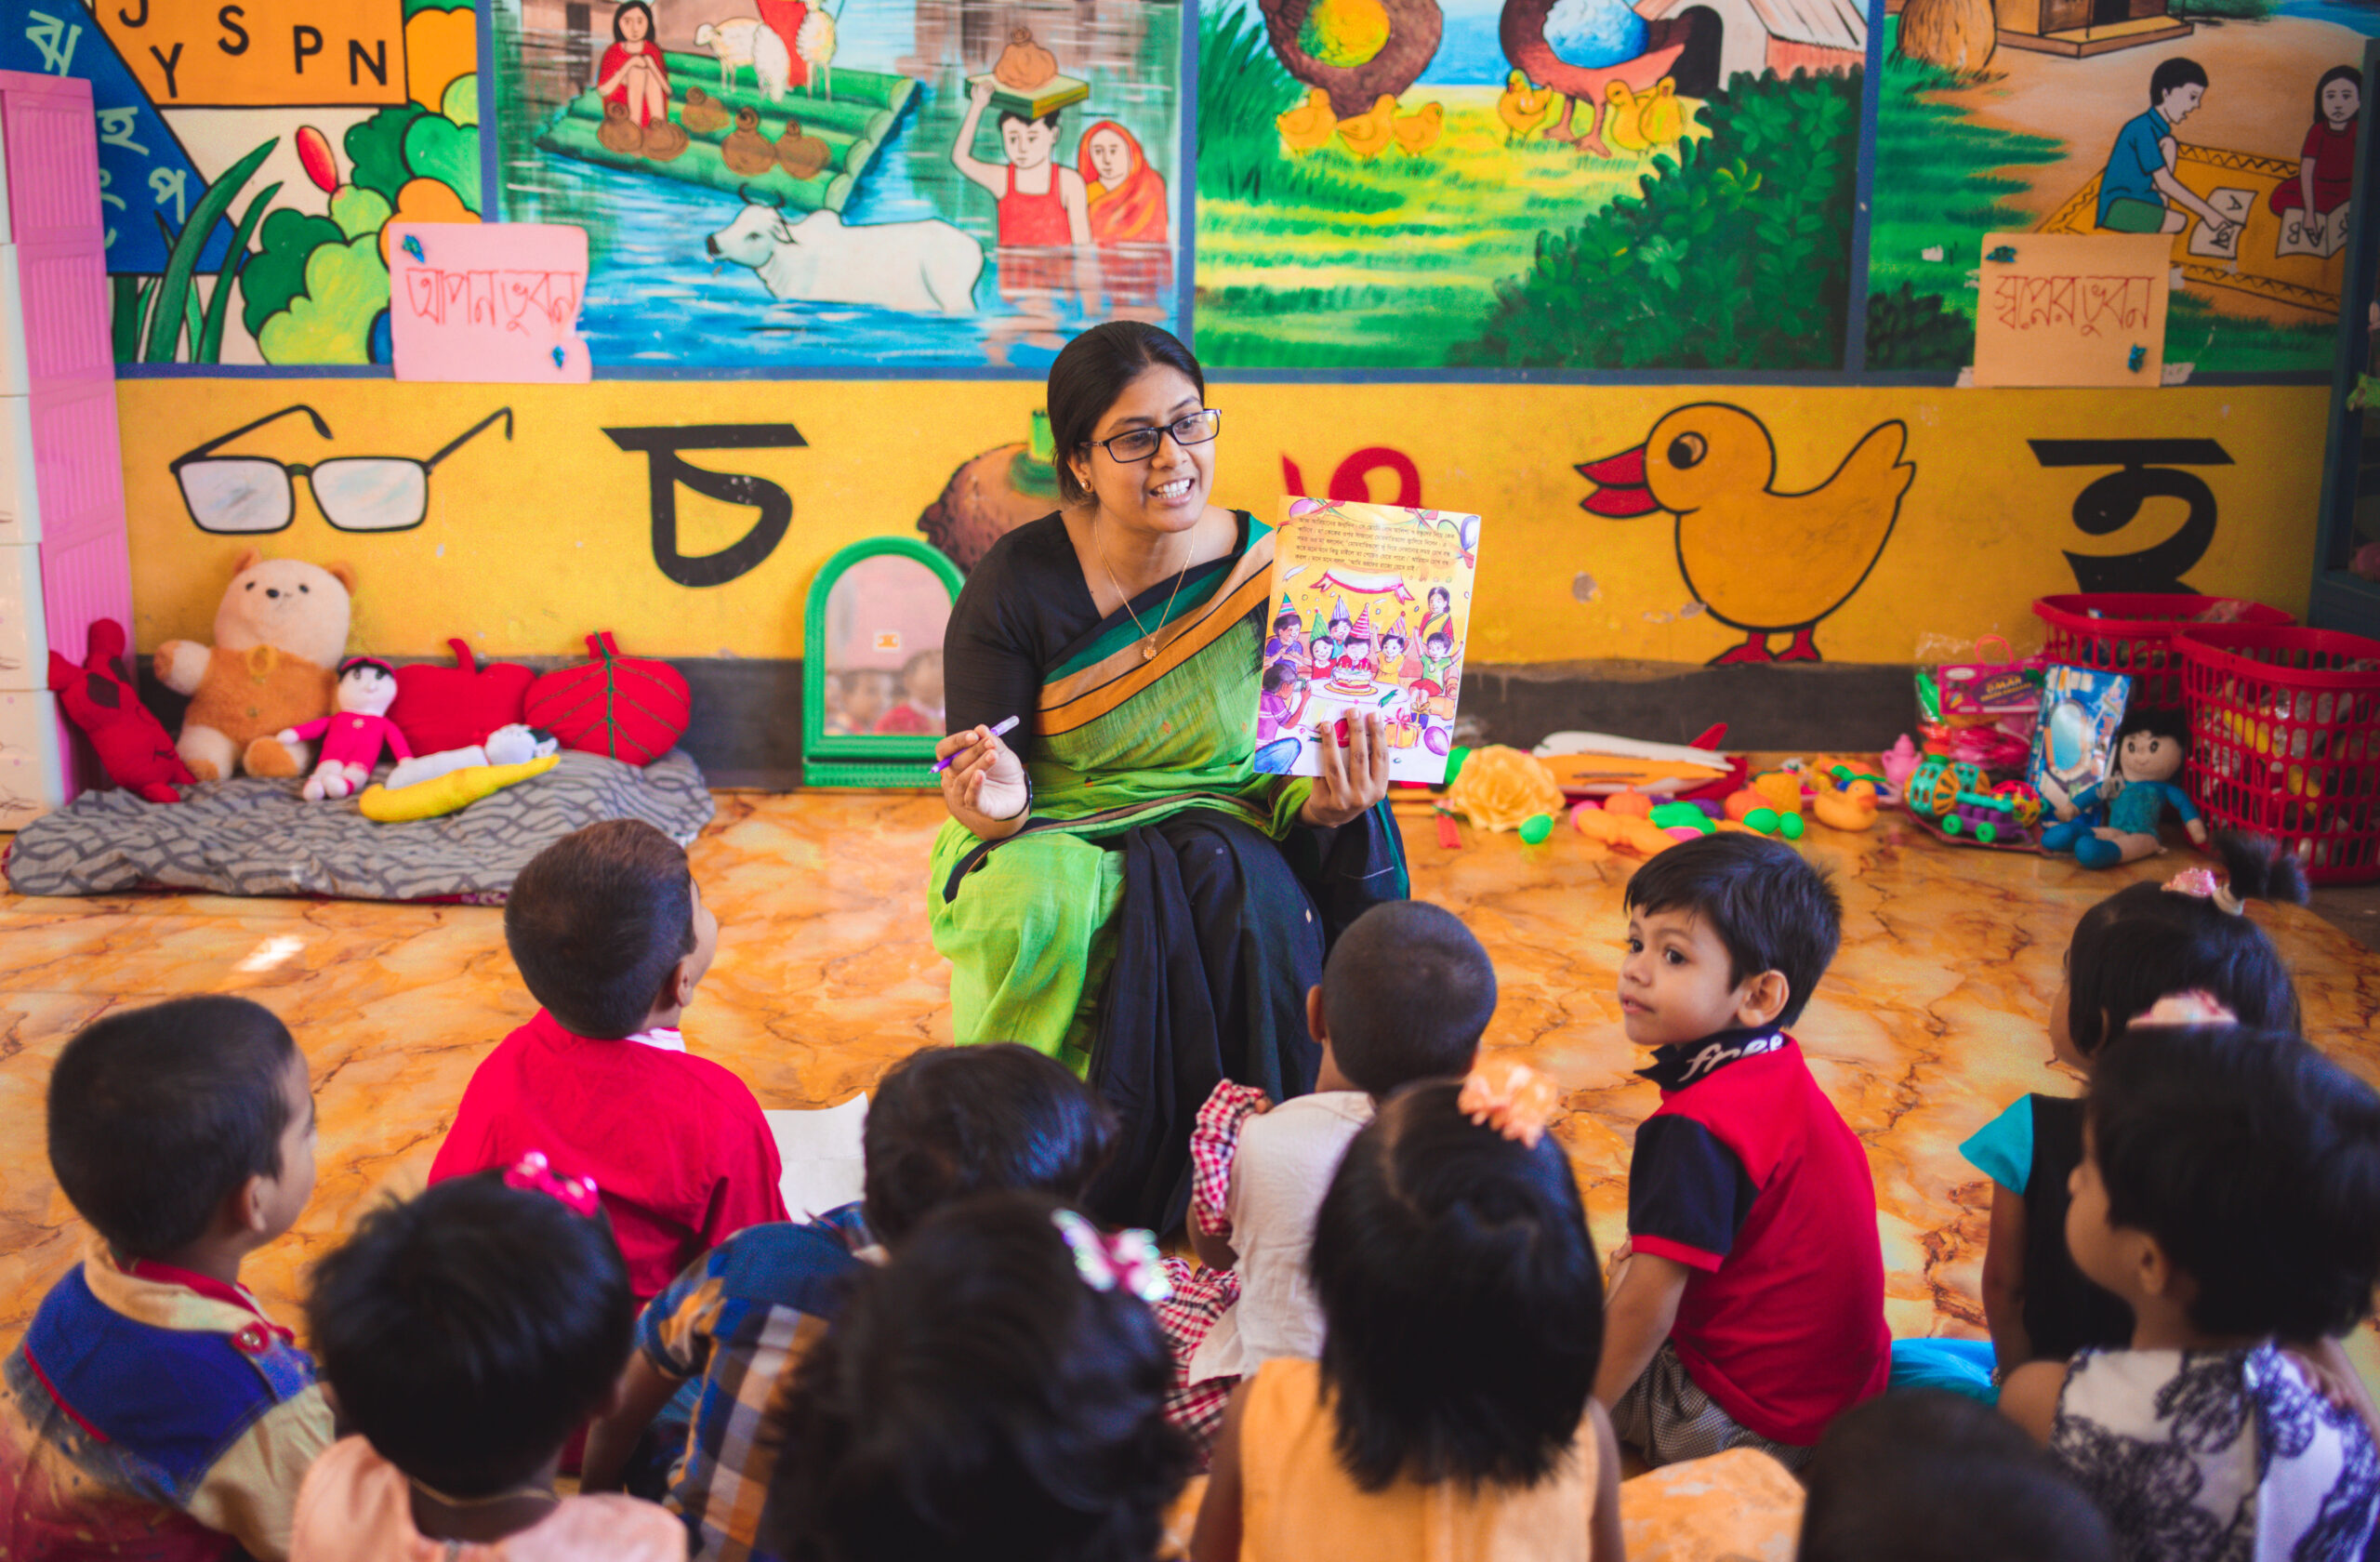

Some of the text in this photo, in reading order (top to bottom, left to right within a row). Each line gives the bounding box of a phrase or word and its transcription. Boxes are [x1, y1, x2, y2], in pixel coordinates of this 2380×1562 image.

[218, 5, 249, 56] S
[293, 25, 323, 74] P
[150, 43, 184, 99] Y
[349, 39, 387, 86] N
[406, 267, 581, 338] আপন ভুবন
[2082, 275, 2155, 338] ভুবন
[600, 423, 810, 588] চ
